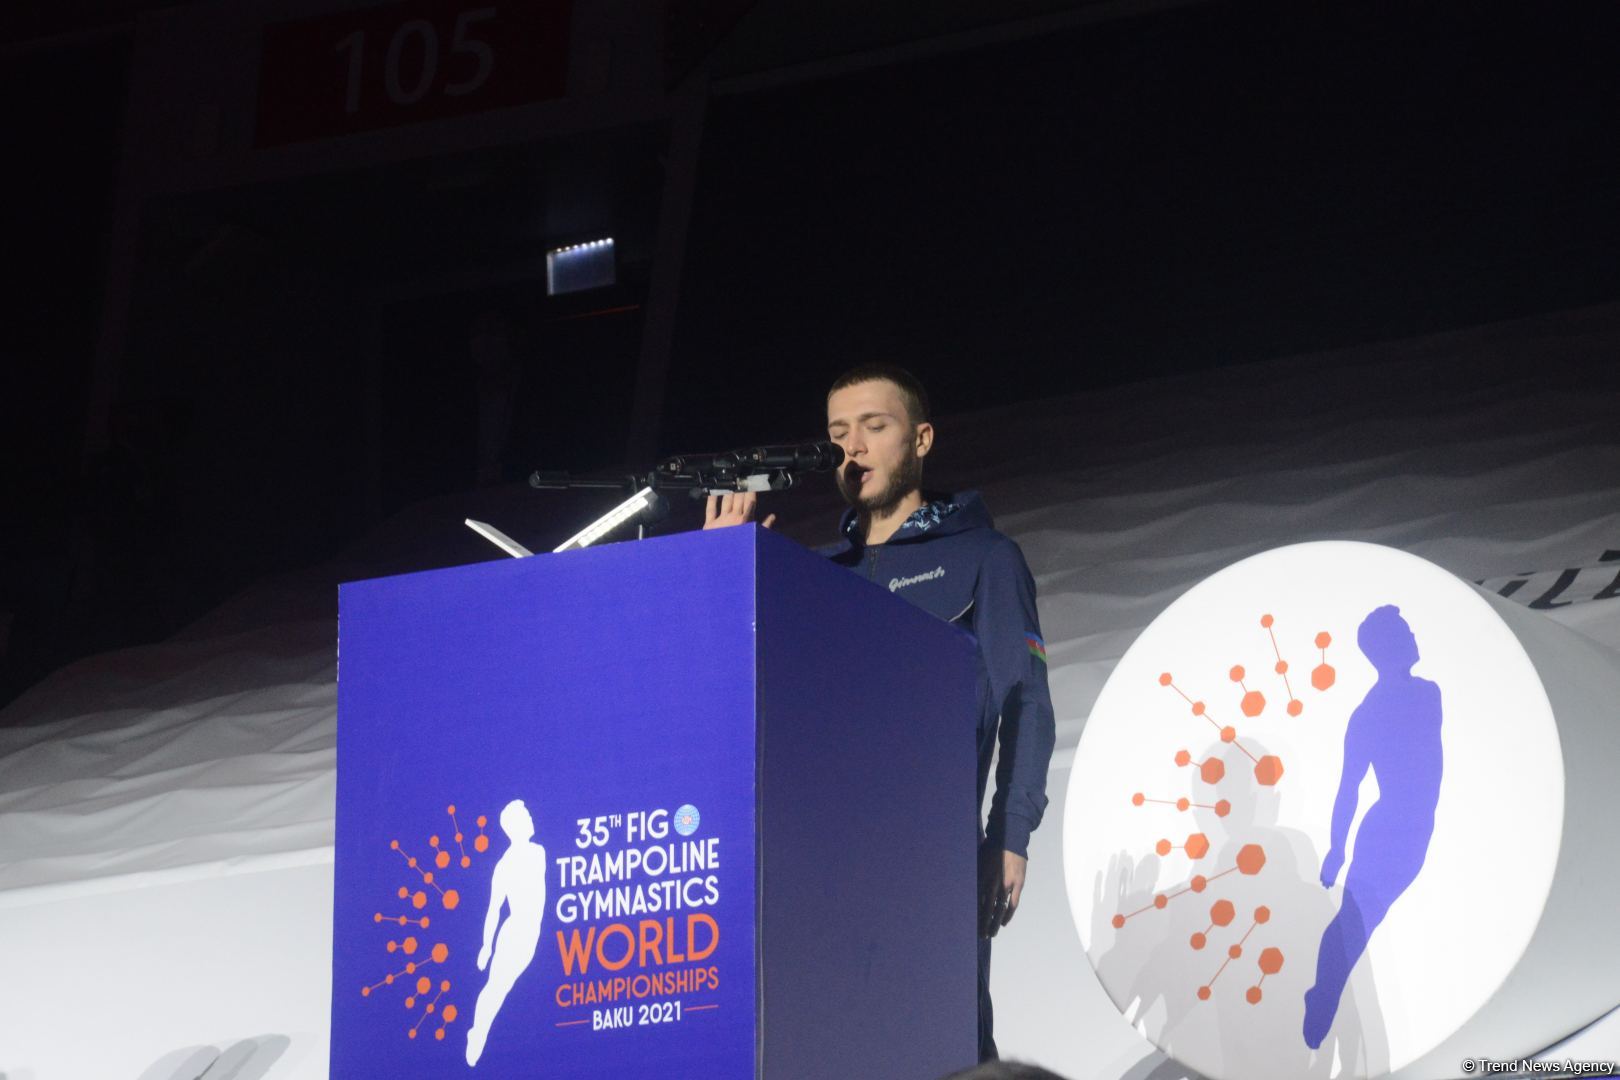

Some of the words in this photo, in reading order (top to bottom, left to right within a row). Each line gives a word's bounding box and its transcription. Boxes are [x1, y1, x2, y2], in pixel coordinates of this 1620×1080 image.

[336, 7, 496, 113] 105
[626, 808, 669, 843] FIG
[556, 837, 720, 888] TRAMPOLINE
[556, 875, 720, 923] GYMNASTICS
[556, 913, 720, 977] WORLD
[555, 966, 719, 1007] CHAMPIONSHIPS
[593, 1006, 634, 1031] BAKU
[638, 1000, 681, 1026] 2021
